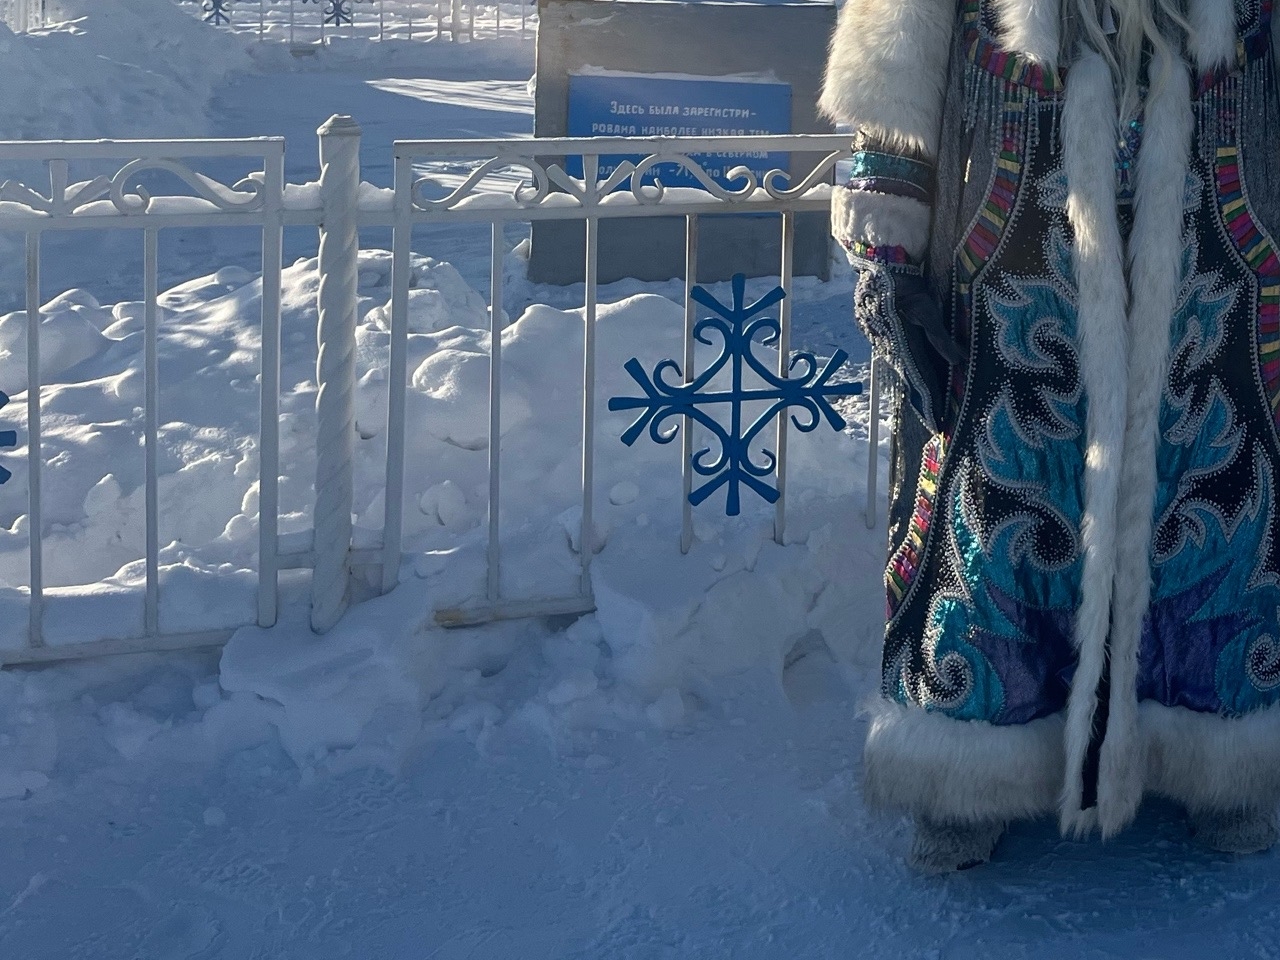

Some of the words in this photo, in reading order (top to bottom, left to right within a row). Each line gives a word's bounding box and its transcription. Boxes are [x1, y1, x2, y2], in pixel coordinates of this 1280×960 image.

[649, 106, 679, 115] БЫЛА
[592, 123, 636, 135] РОВАНА
[641, 126, 697, 136] НАИБОЛЕЕ
